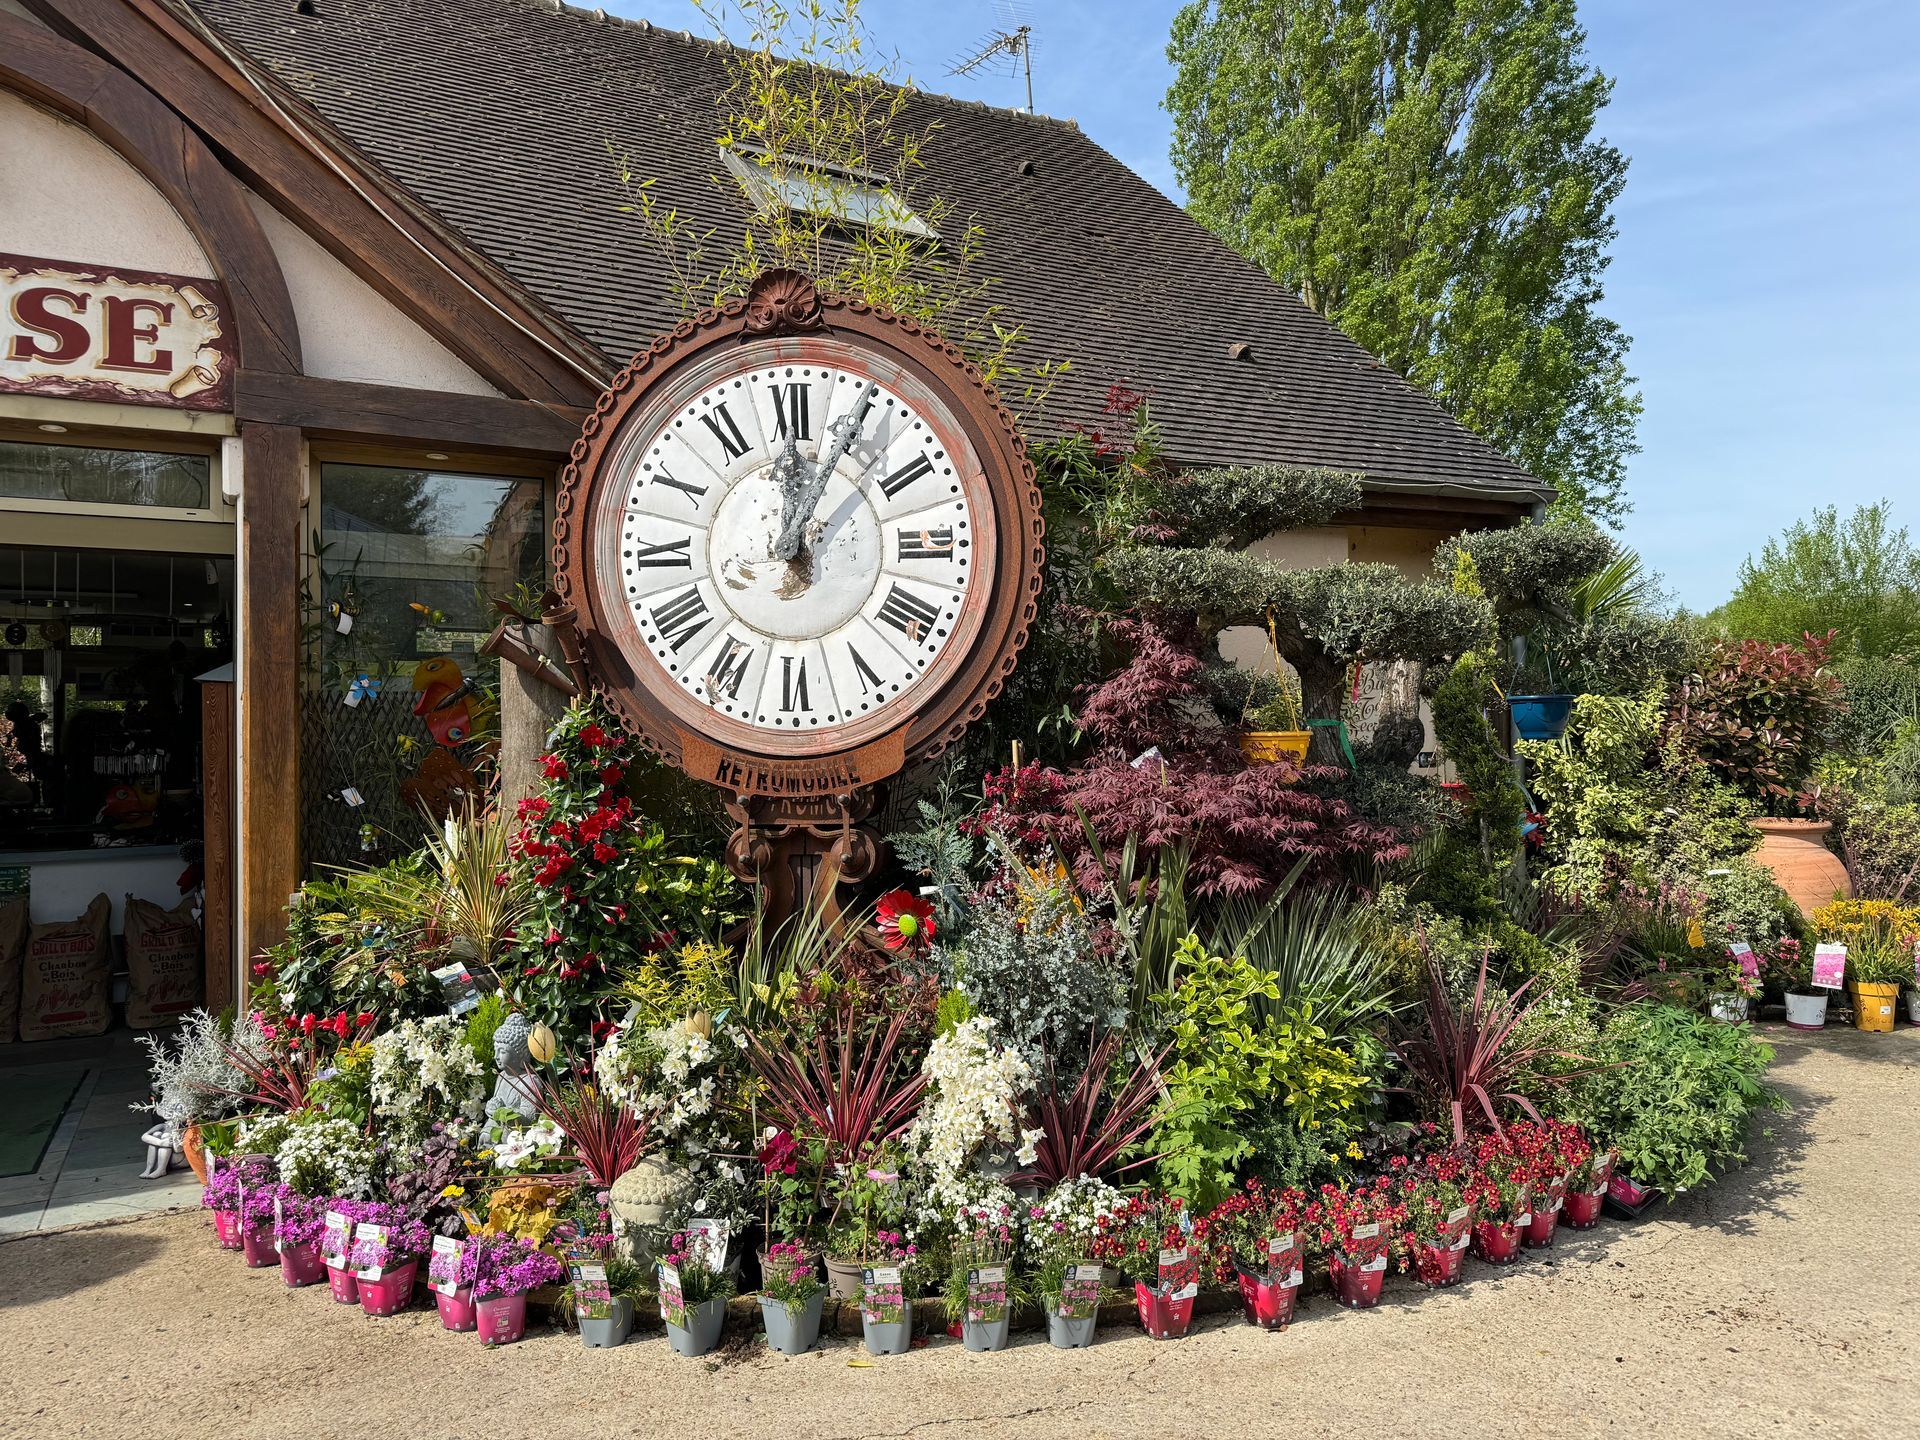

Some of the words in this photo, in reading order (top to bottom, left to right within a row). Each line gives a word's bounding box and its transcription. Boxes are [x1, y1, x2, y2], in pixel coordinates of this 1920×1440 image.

[698, 401, 754, 467] XI
[768, 383, 813, 442] XII
[650, 461, 709, 510] X
[877, 450, 936, 502] II
[637, 535, 693, 571] IX
[898, 525, 954, 563] III
[650, 583, 714, 655] VIII
[779, 656, 813, 712] VI
[847, 641, 886, 695] V
[715, 753, 861, 793] RETROMOBILE
[51, 969, 75, 979] Bois
